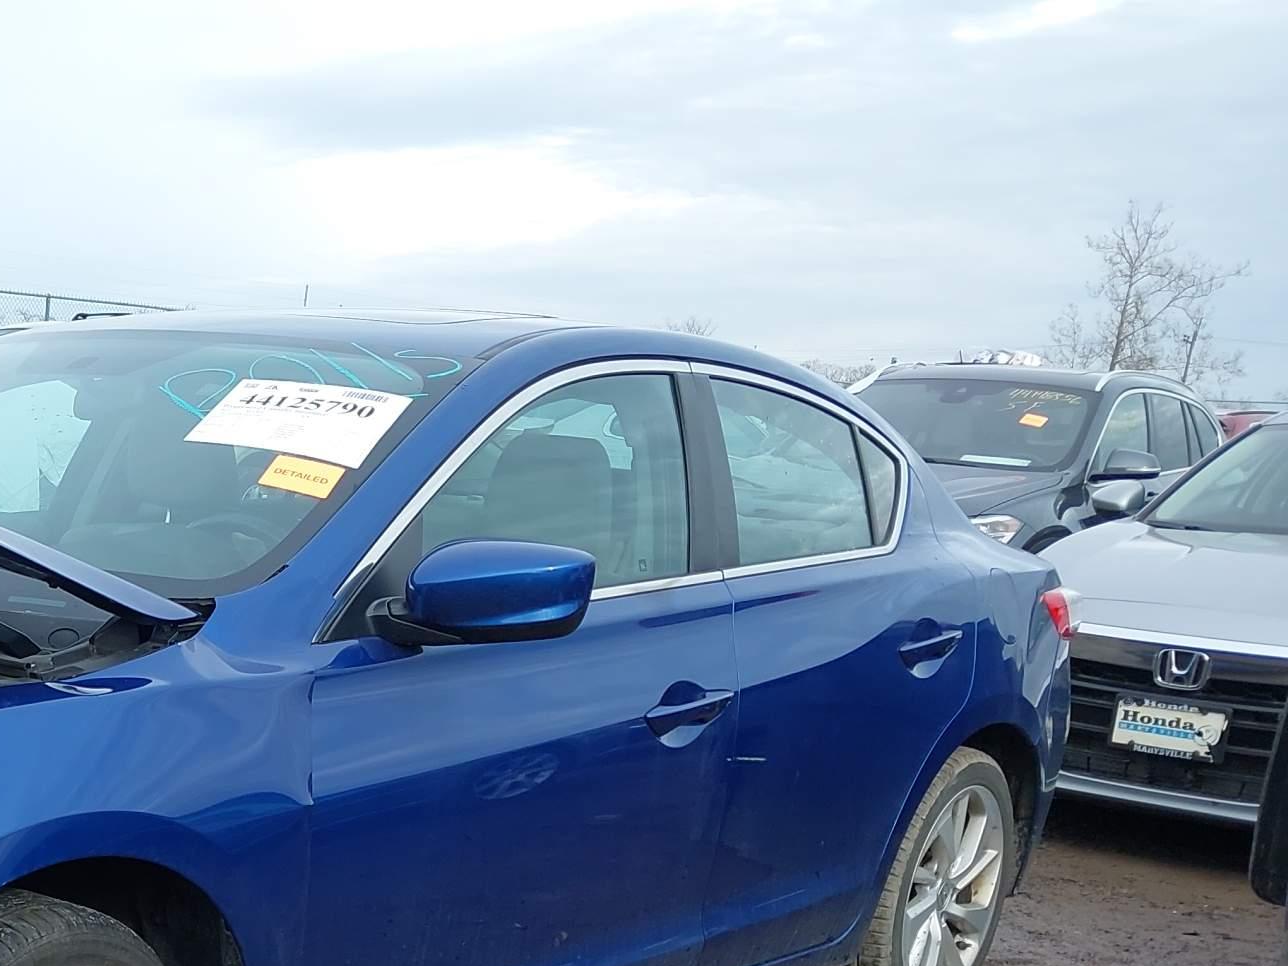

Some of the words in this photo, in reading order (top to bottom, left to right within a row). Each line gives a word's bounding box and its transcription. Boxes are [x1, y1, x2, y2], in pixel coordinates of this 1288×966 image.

[240, 394, 375, 418] 44125790
[273, 466, 329, 486] DETAILED
[1143, 698, 1200, 712] Honda
[1120, 709, 1195, 731] Honda
[1133, 743, 1193, 760] MARYSVILLE
